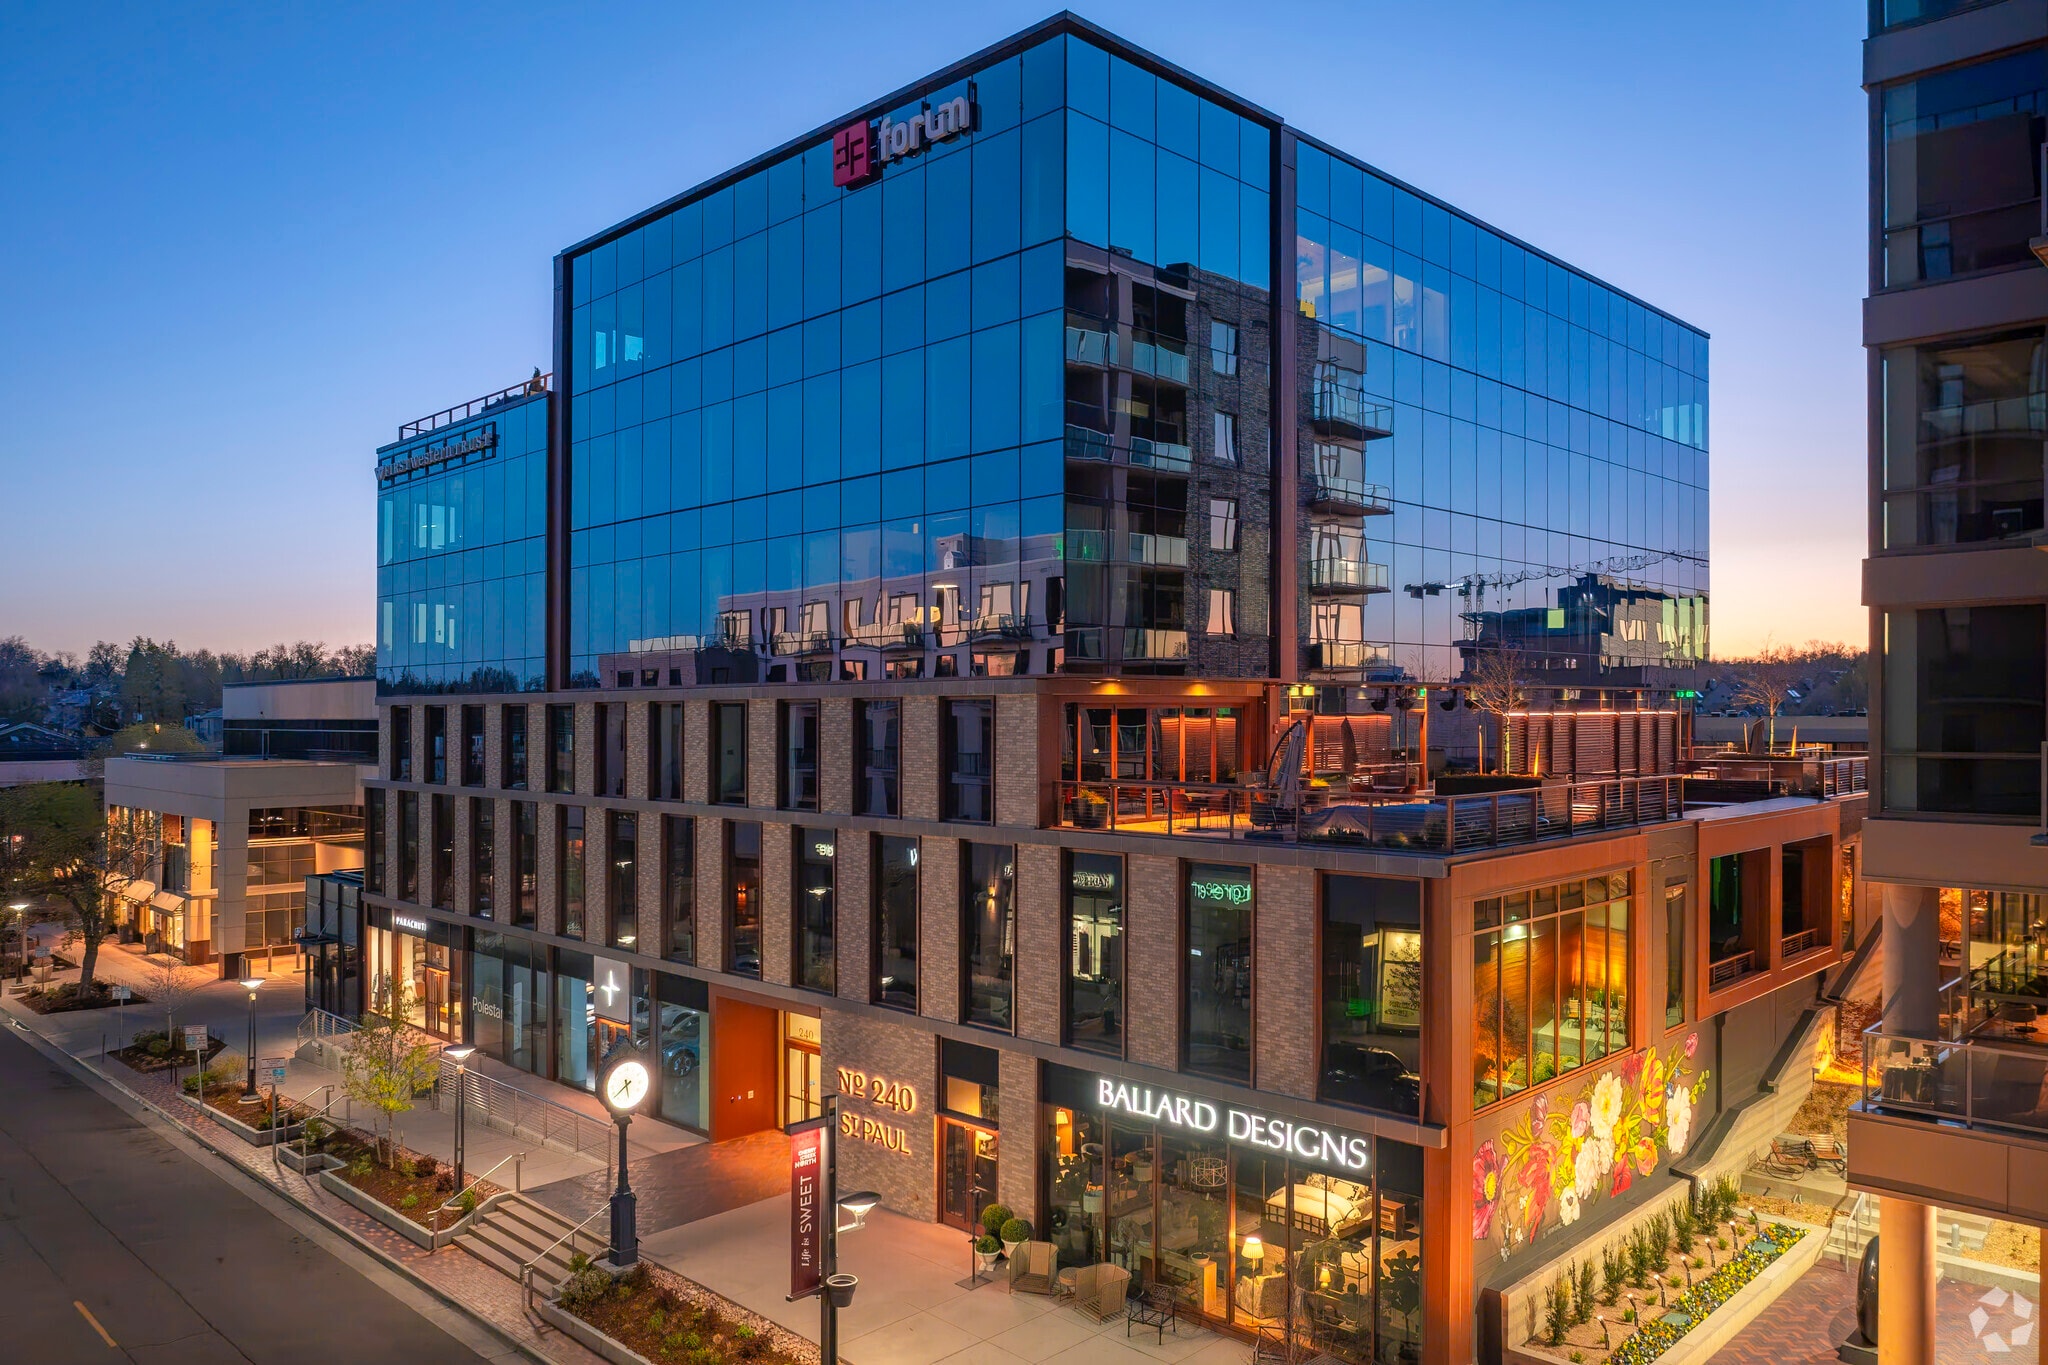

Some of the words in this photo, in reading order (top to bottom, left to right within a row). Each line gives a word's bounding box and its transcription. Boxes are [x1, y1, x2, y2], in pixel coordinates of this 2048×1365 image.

[878, 96, 970, 162] forum
[798, 1028, 814, 1040] 240
[871, 1079, 914, 1112] 240
[862, 1118, 911, 1155] PAUL
[1098, 1078, 1217, 1132] BALLARD
[1228, 1109, 1367, 1169] DESIGNS
[794, 1157, 817, 1169] NORTH
[800, 1175, 813, 1234] SWEET
[801, 1237, 810, 1246] is
[801, 1248, 811, 1267] Life
